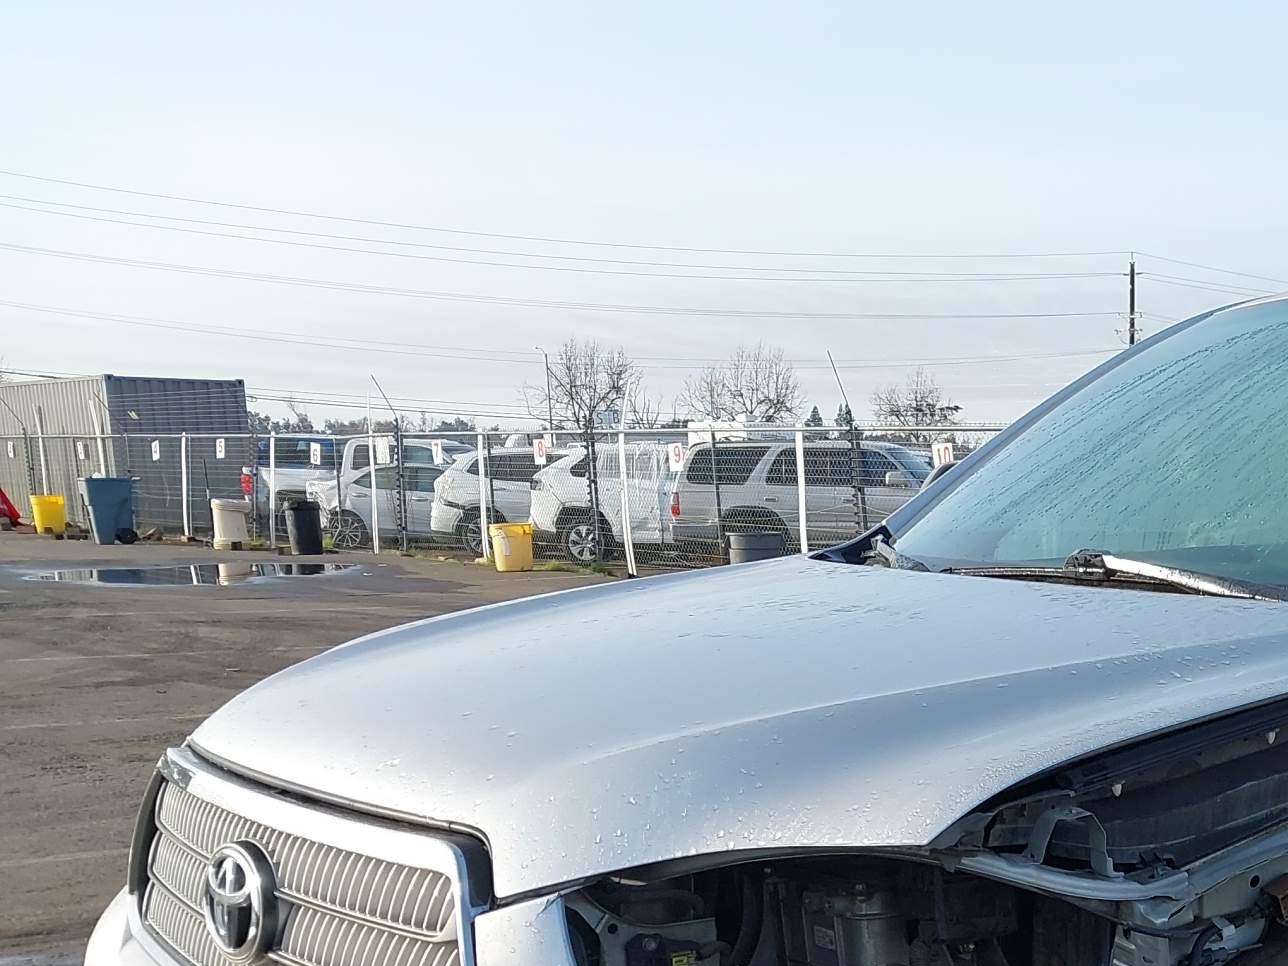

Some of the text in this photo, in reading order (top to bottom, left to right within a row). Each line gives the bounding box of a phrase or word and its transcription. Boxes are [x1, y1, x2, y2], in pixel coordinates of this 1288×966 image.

[312, 448, 318, 463] 6
[537, 441, 544, 458] 8
[673, 445, 681, 463] 9
